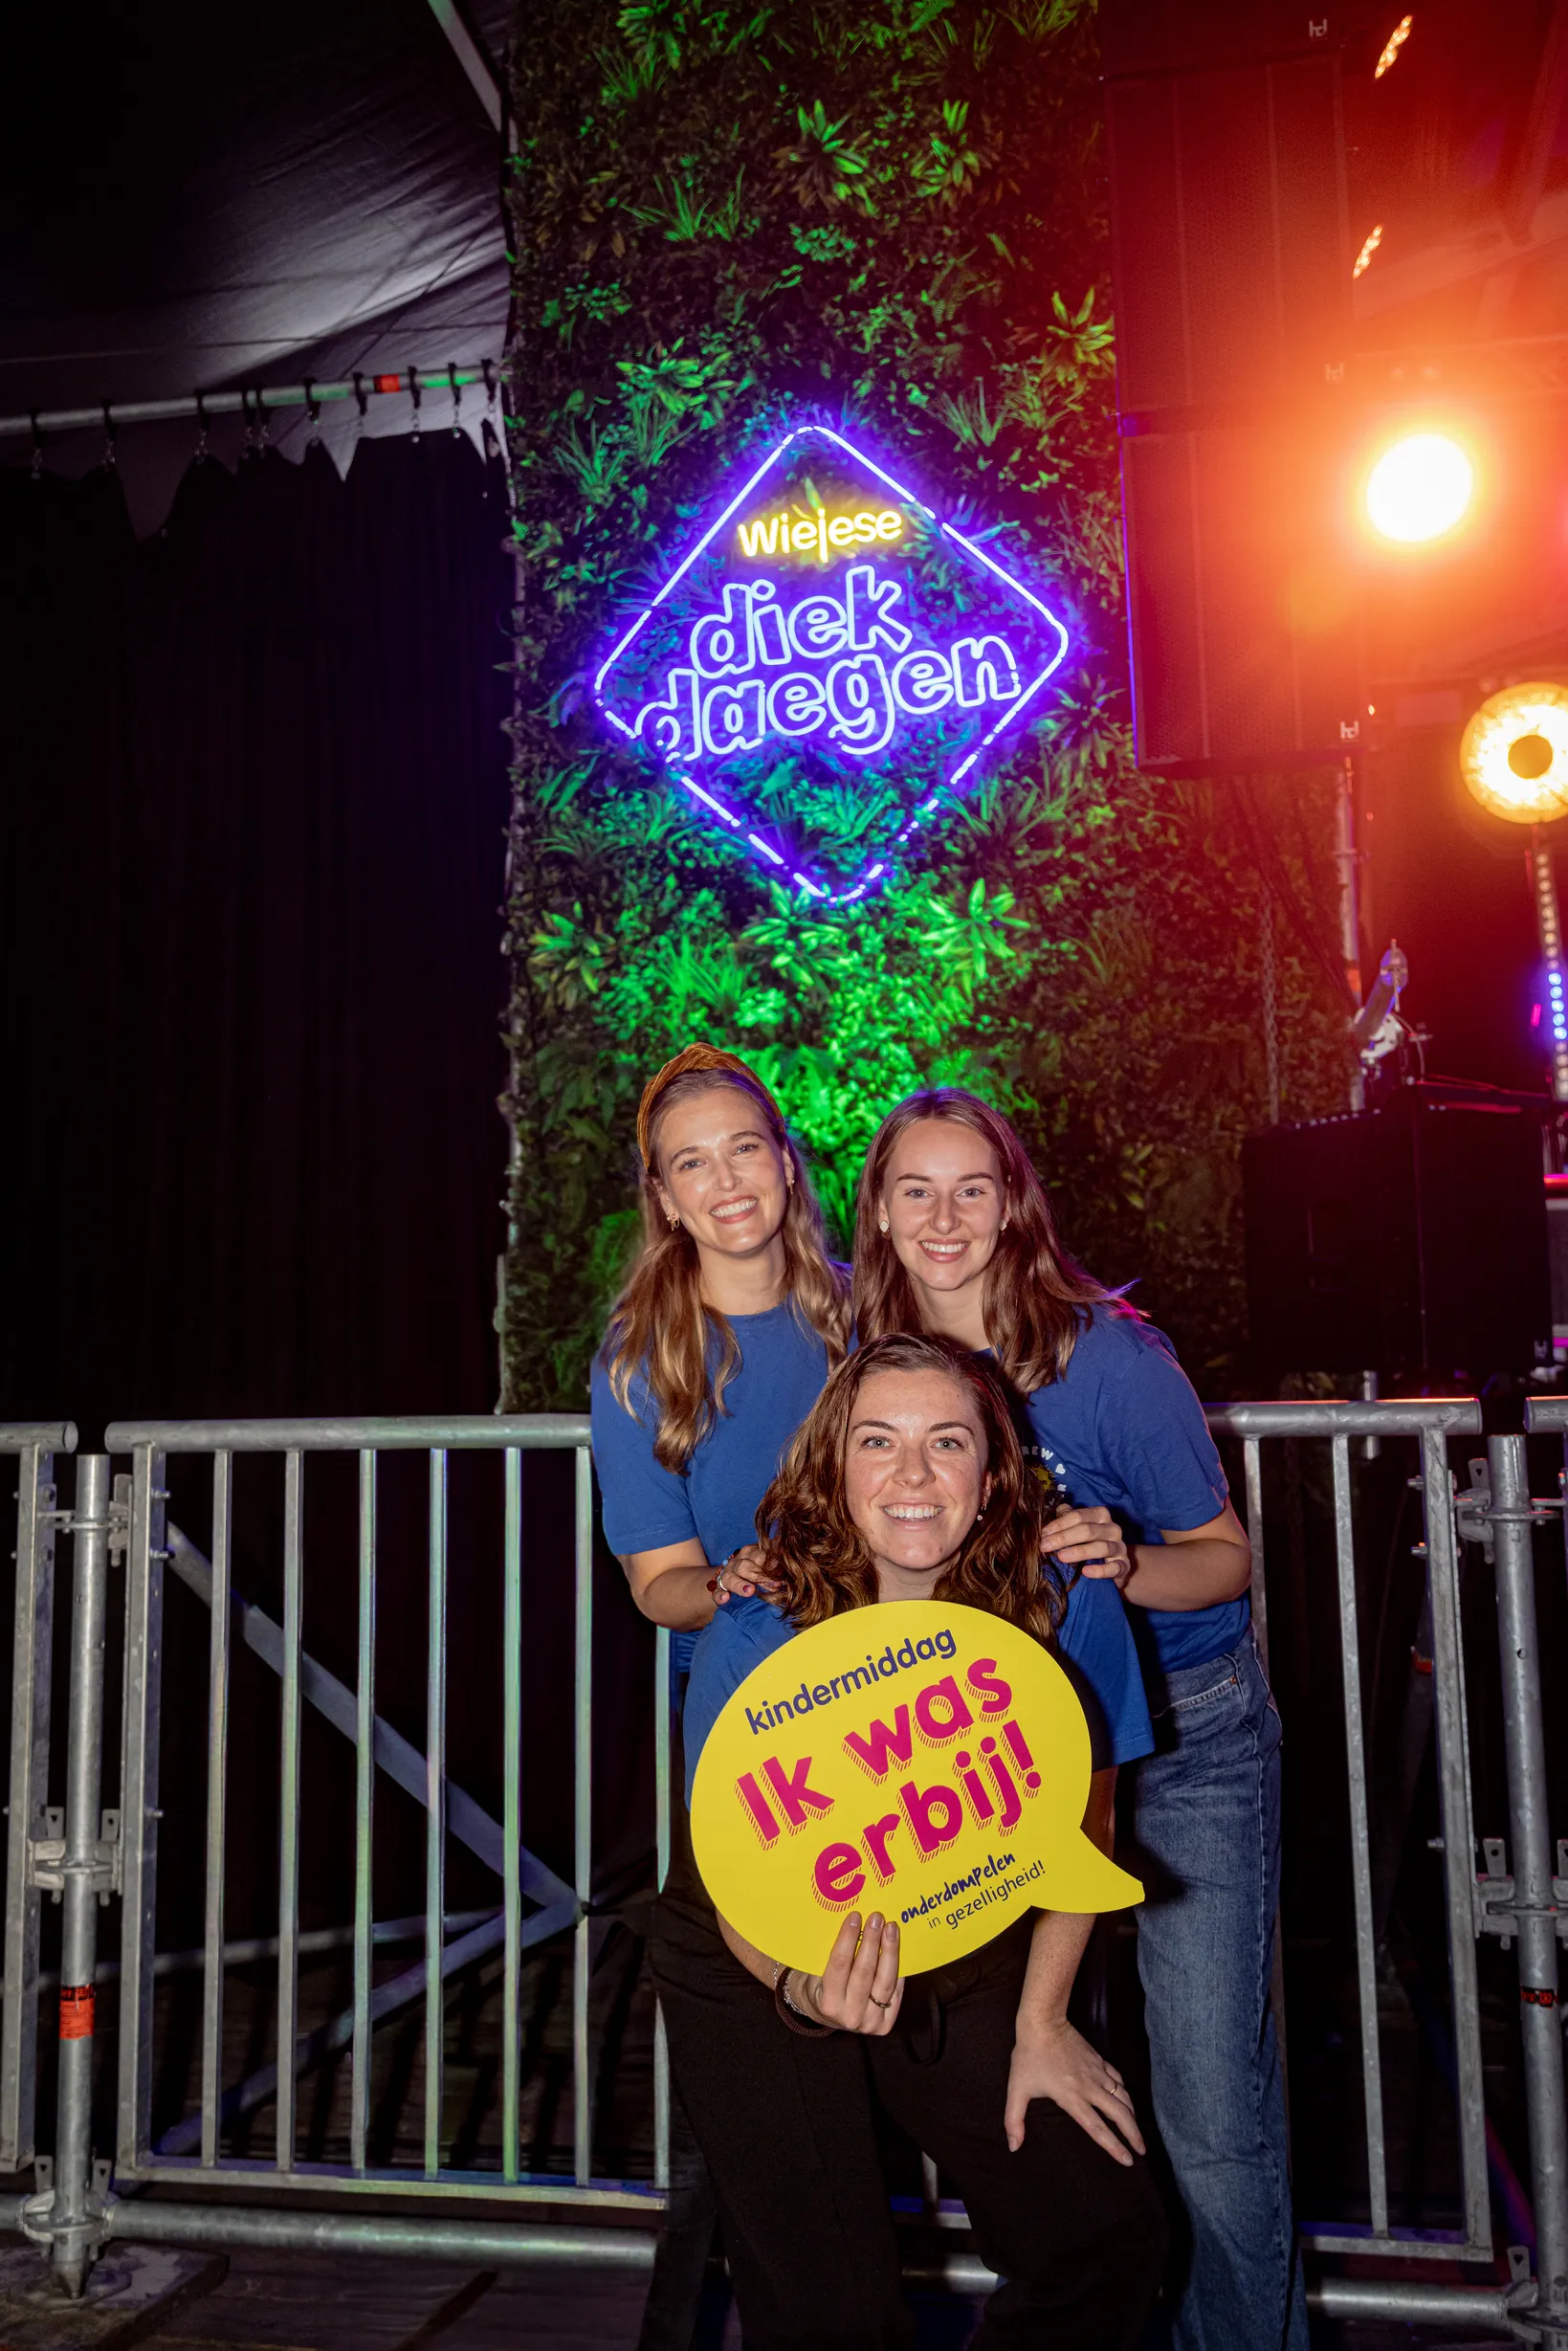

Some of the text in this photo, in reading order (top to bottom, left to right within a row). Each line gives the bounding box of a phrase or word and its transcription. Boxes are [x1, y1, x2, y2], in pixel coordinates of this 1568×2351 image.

[691, 566, 913, 678] diek
[635, 636, 1021, 762] daegen
[745, 1630, 957, 1734] kindermiddag
[735, 1658, 1012, 1851] Ik was
[811, 1720, 1042, 1913] erbij!
[927, 1860, 1046, 1929] in gezelligheid!
